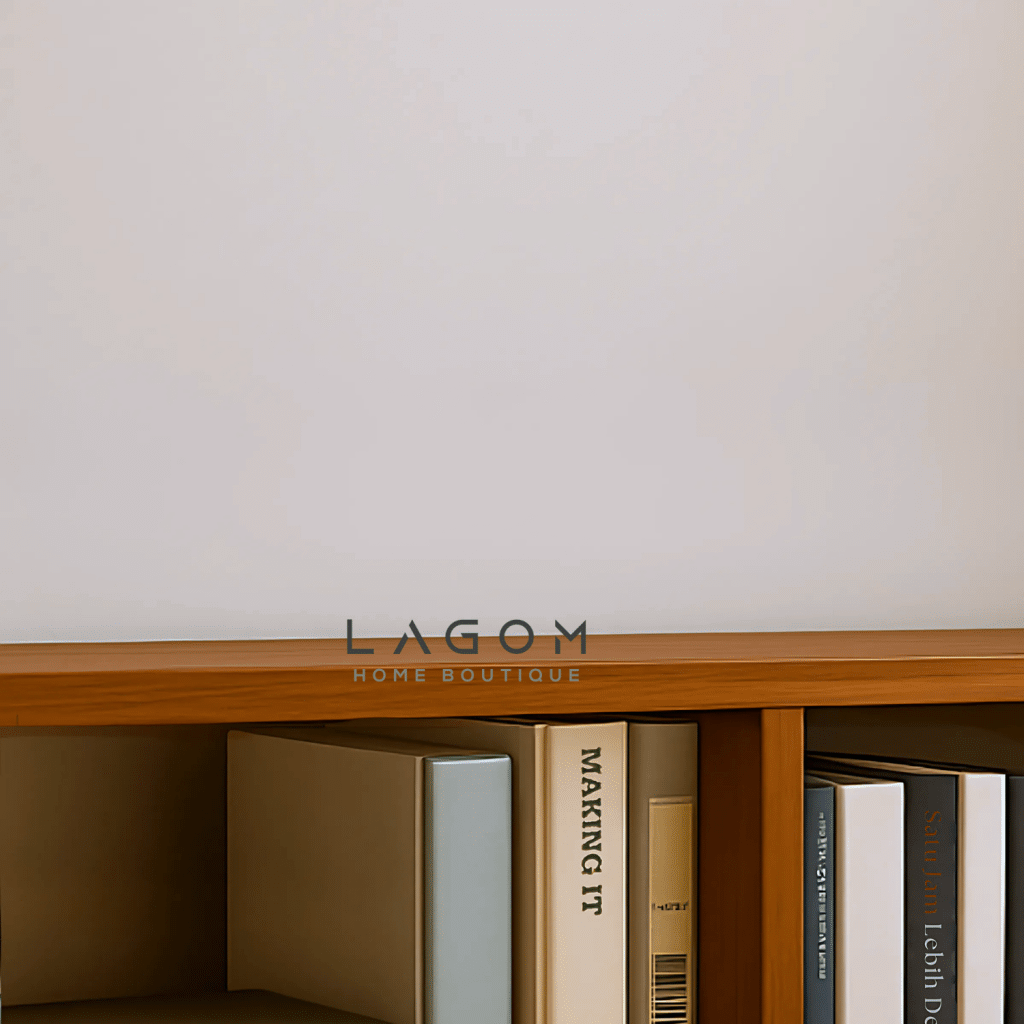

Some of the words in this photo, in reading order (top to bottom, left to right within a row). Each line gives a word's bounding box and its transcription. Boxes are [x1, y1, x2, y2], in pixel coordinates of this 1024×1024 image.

[580, 746, 603, 876] MAKING
[922, 809, 942, 866] Satu
[581, 885, 603, 916] IT
[922, 868, 942, 915] Jam
[924, 924, 944, 988] Lebih
